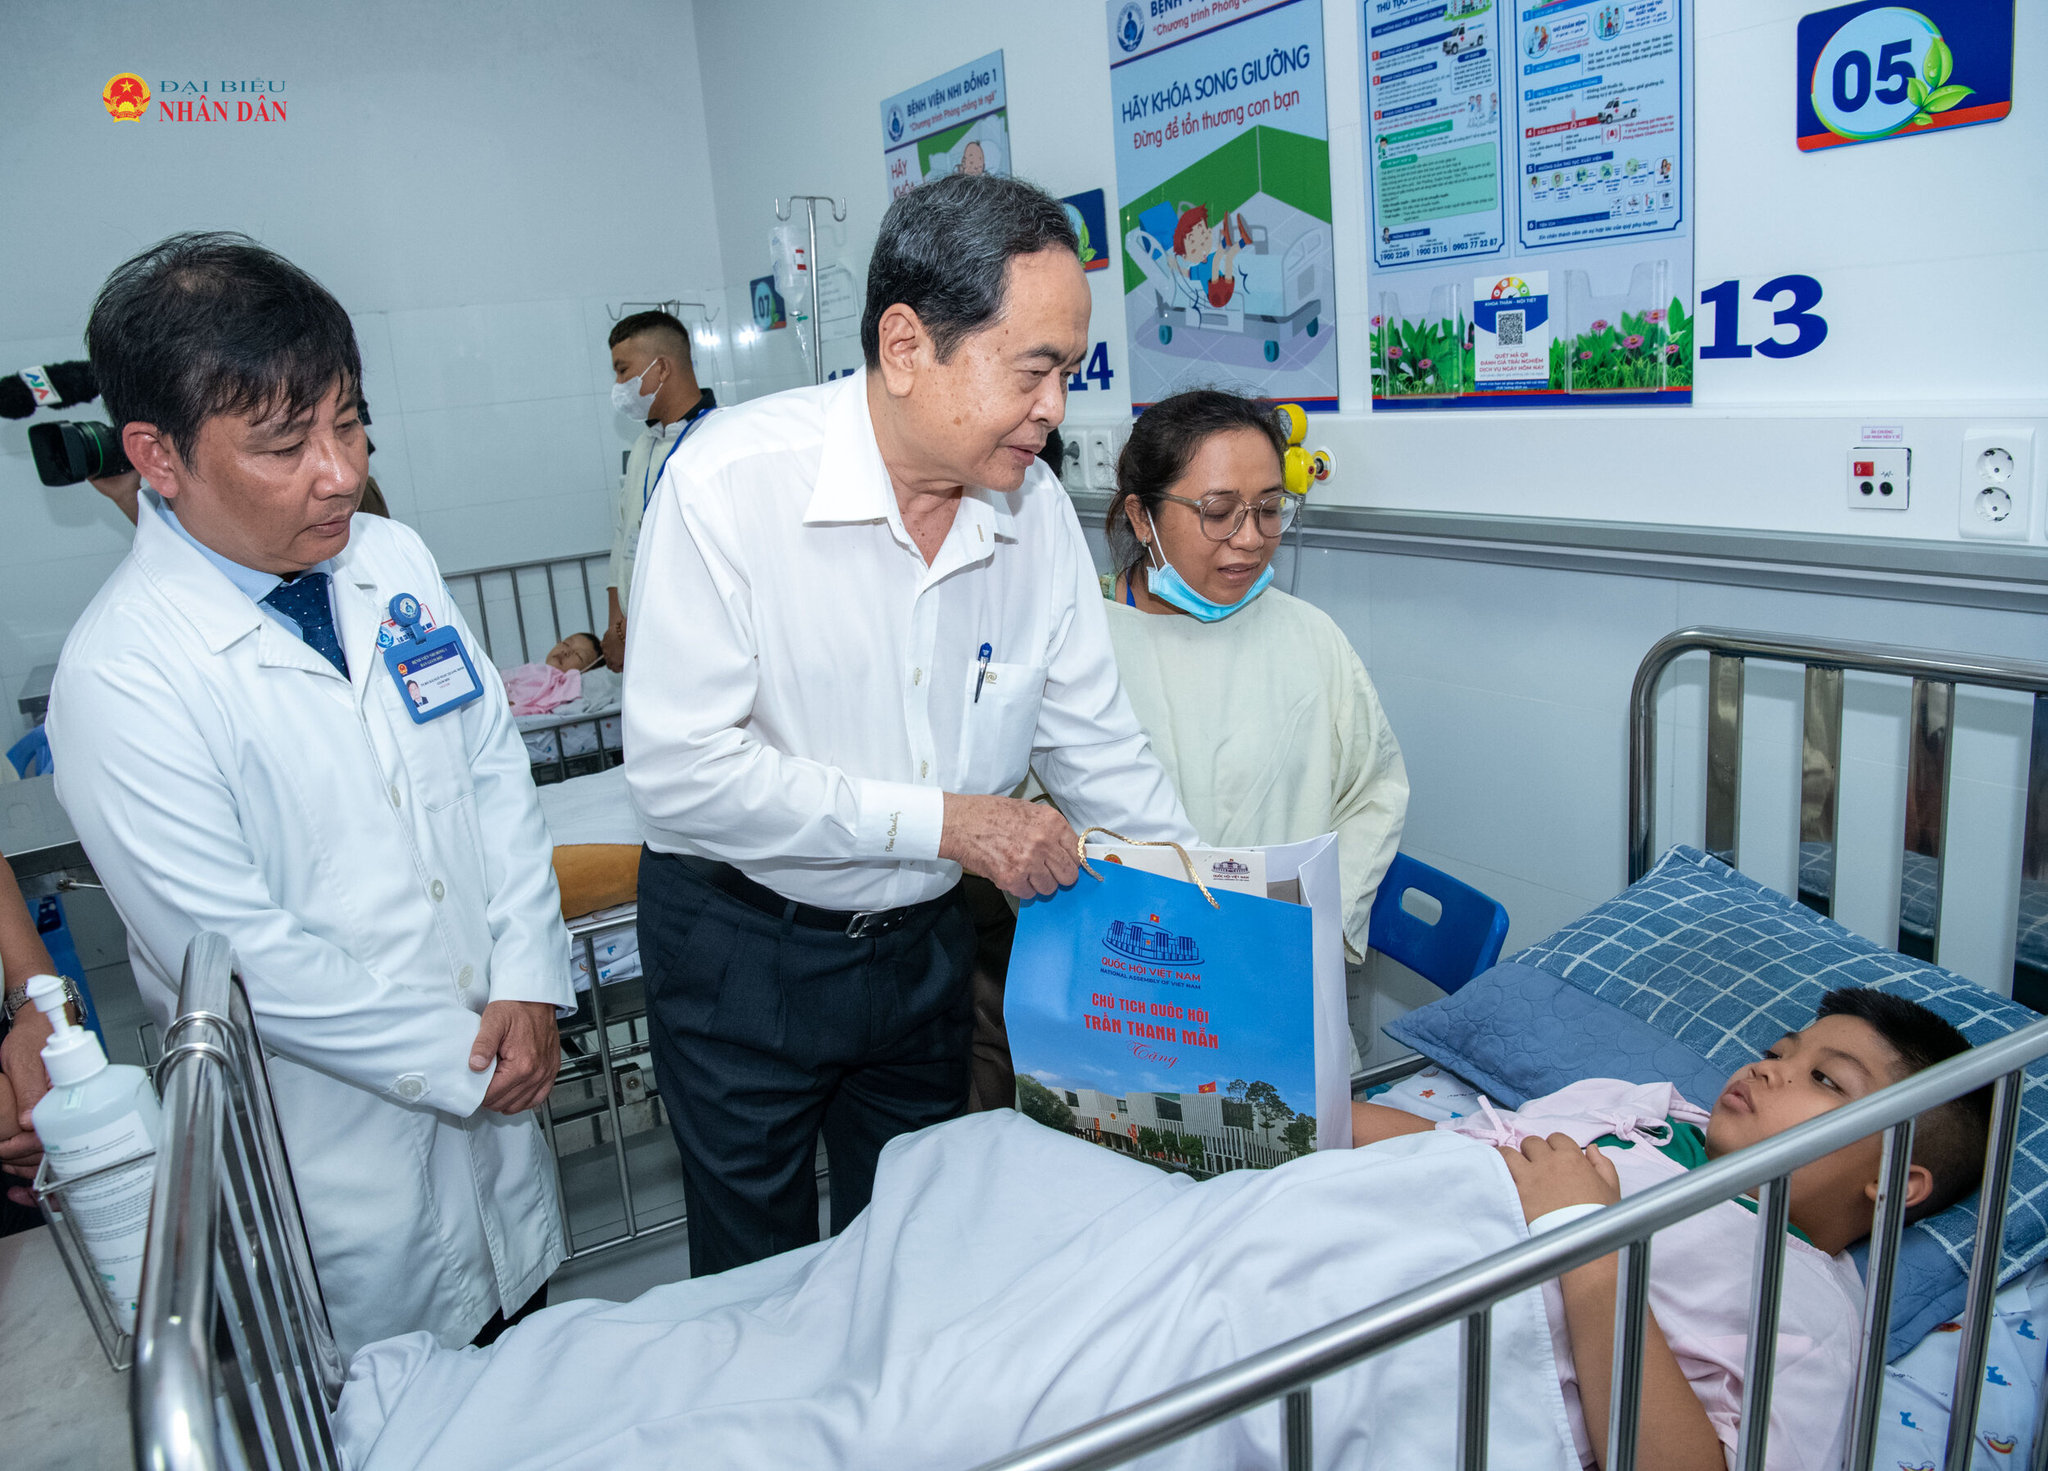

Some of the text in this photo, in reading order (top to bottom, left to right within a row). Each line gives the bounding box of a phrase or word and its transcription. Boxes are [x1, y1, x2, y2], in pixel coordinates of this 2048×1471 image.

[1122, 44, 1310, 124] HÃY KHÓA SONG GIƯỜNG
[1832, 38, 1917, 113] 05
[907, 68, 997, 119] BỆNH VIỆN NHI ĐỒNG 1
[1133, 89, 1300, 150] Đừng để tổn thương con bạn
[890, 158, 908, 180] HÃY
[1416, 247, 1431, 256] 1900
[1432, 245, 1448, 254] 2115
[1453, 242, 1468, 251] 0903
[1470, 240, 1478, 249] 77
[1480, 239, 1488, 247] 22
[758, 295, 771, 318] 07
[1699, 273, 1829, 360] 13
[1100, 968, 1128, 979] NATIONAL
[1128, 974, 1161, 984] ASSEMBLY
[1101, 956, 1201, 982] QUỐC HỘI VIỆT NAM
[1092, 992, 1209, 1026] CHỦ TỊCH QUỐC HỘI
[1083, 1011, 1219, 1050] TRẦN THANH MẪN
[1127, 1040, 1178, 1069] Tặng
